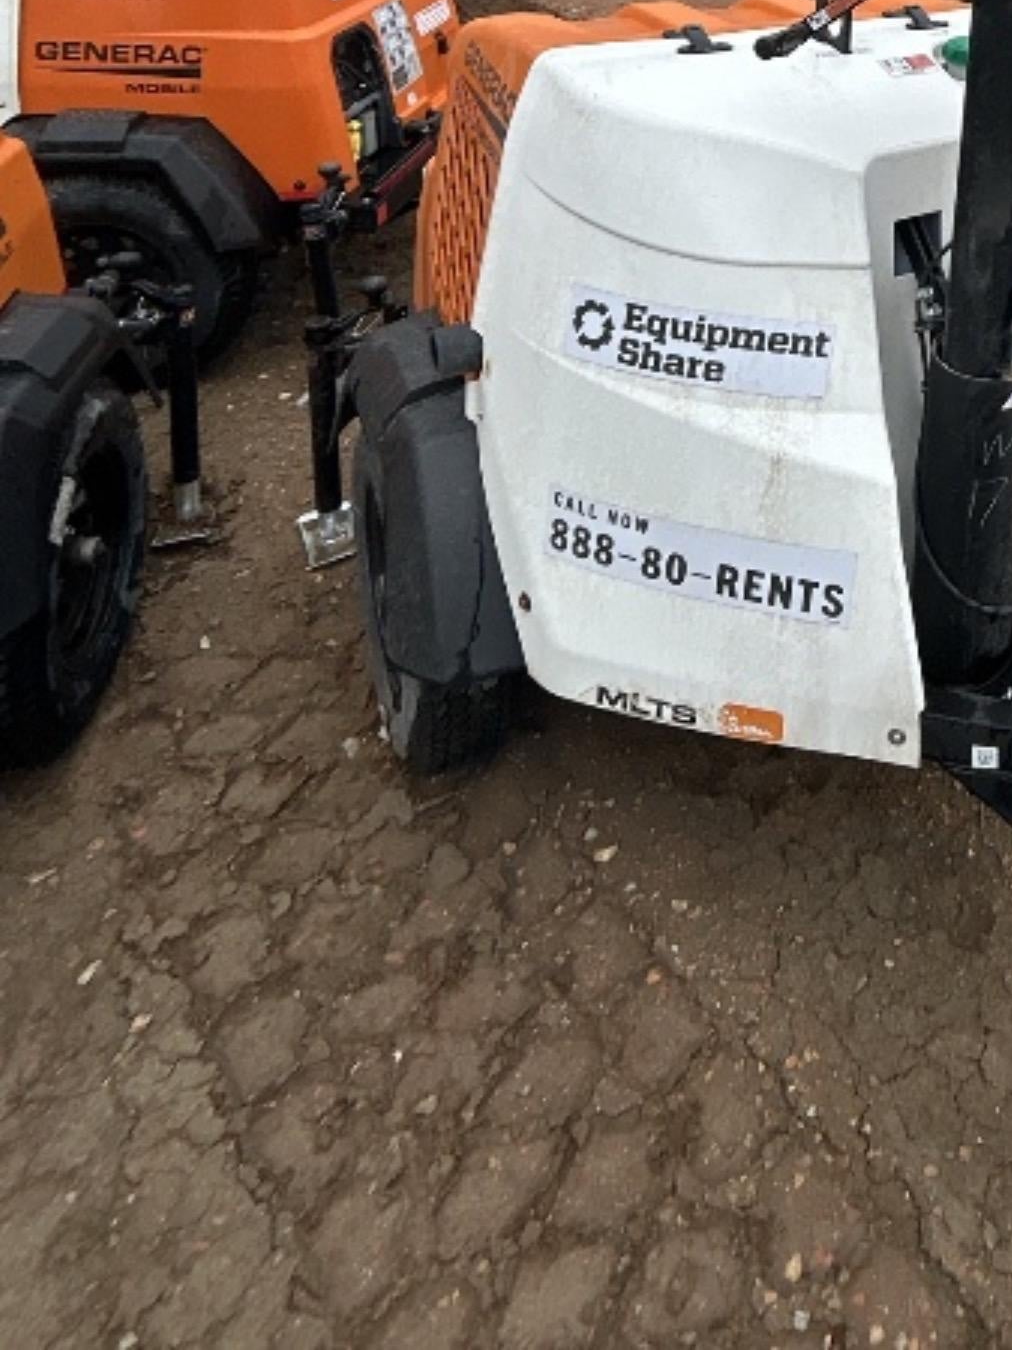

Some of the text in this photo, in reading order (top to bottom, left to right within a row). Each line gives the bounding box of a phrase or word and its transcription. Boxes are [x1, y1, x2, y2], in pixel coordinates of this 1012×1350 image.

[35, 41, 203, 64] GENERAC
[125, 83, 202, 95] MOBILE
[622, 302, 831, 358] Equipment
[616, 337, 726, 382] Share
[553, 491, 649, 535] CALL NOW
[549, 518, 845, 619] 888-80-RENTS
[595, 685, 697, 724] MLTS
